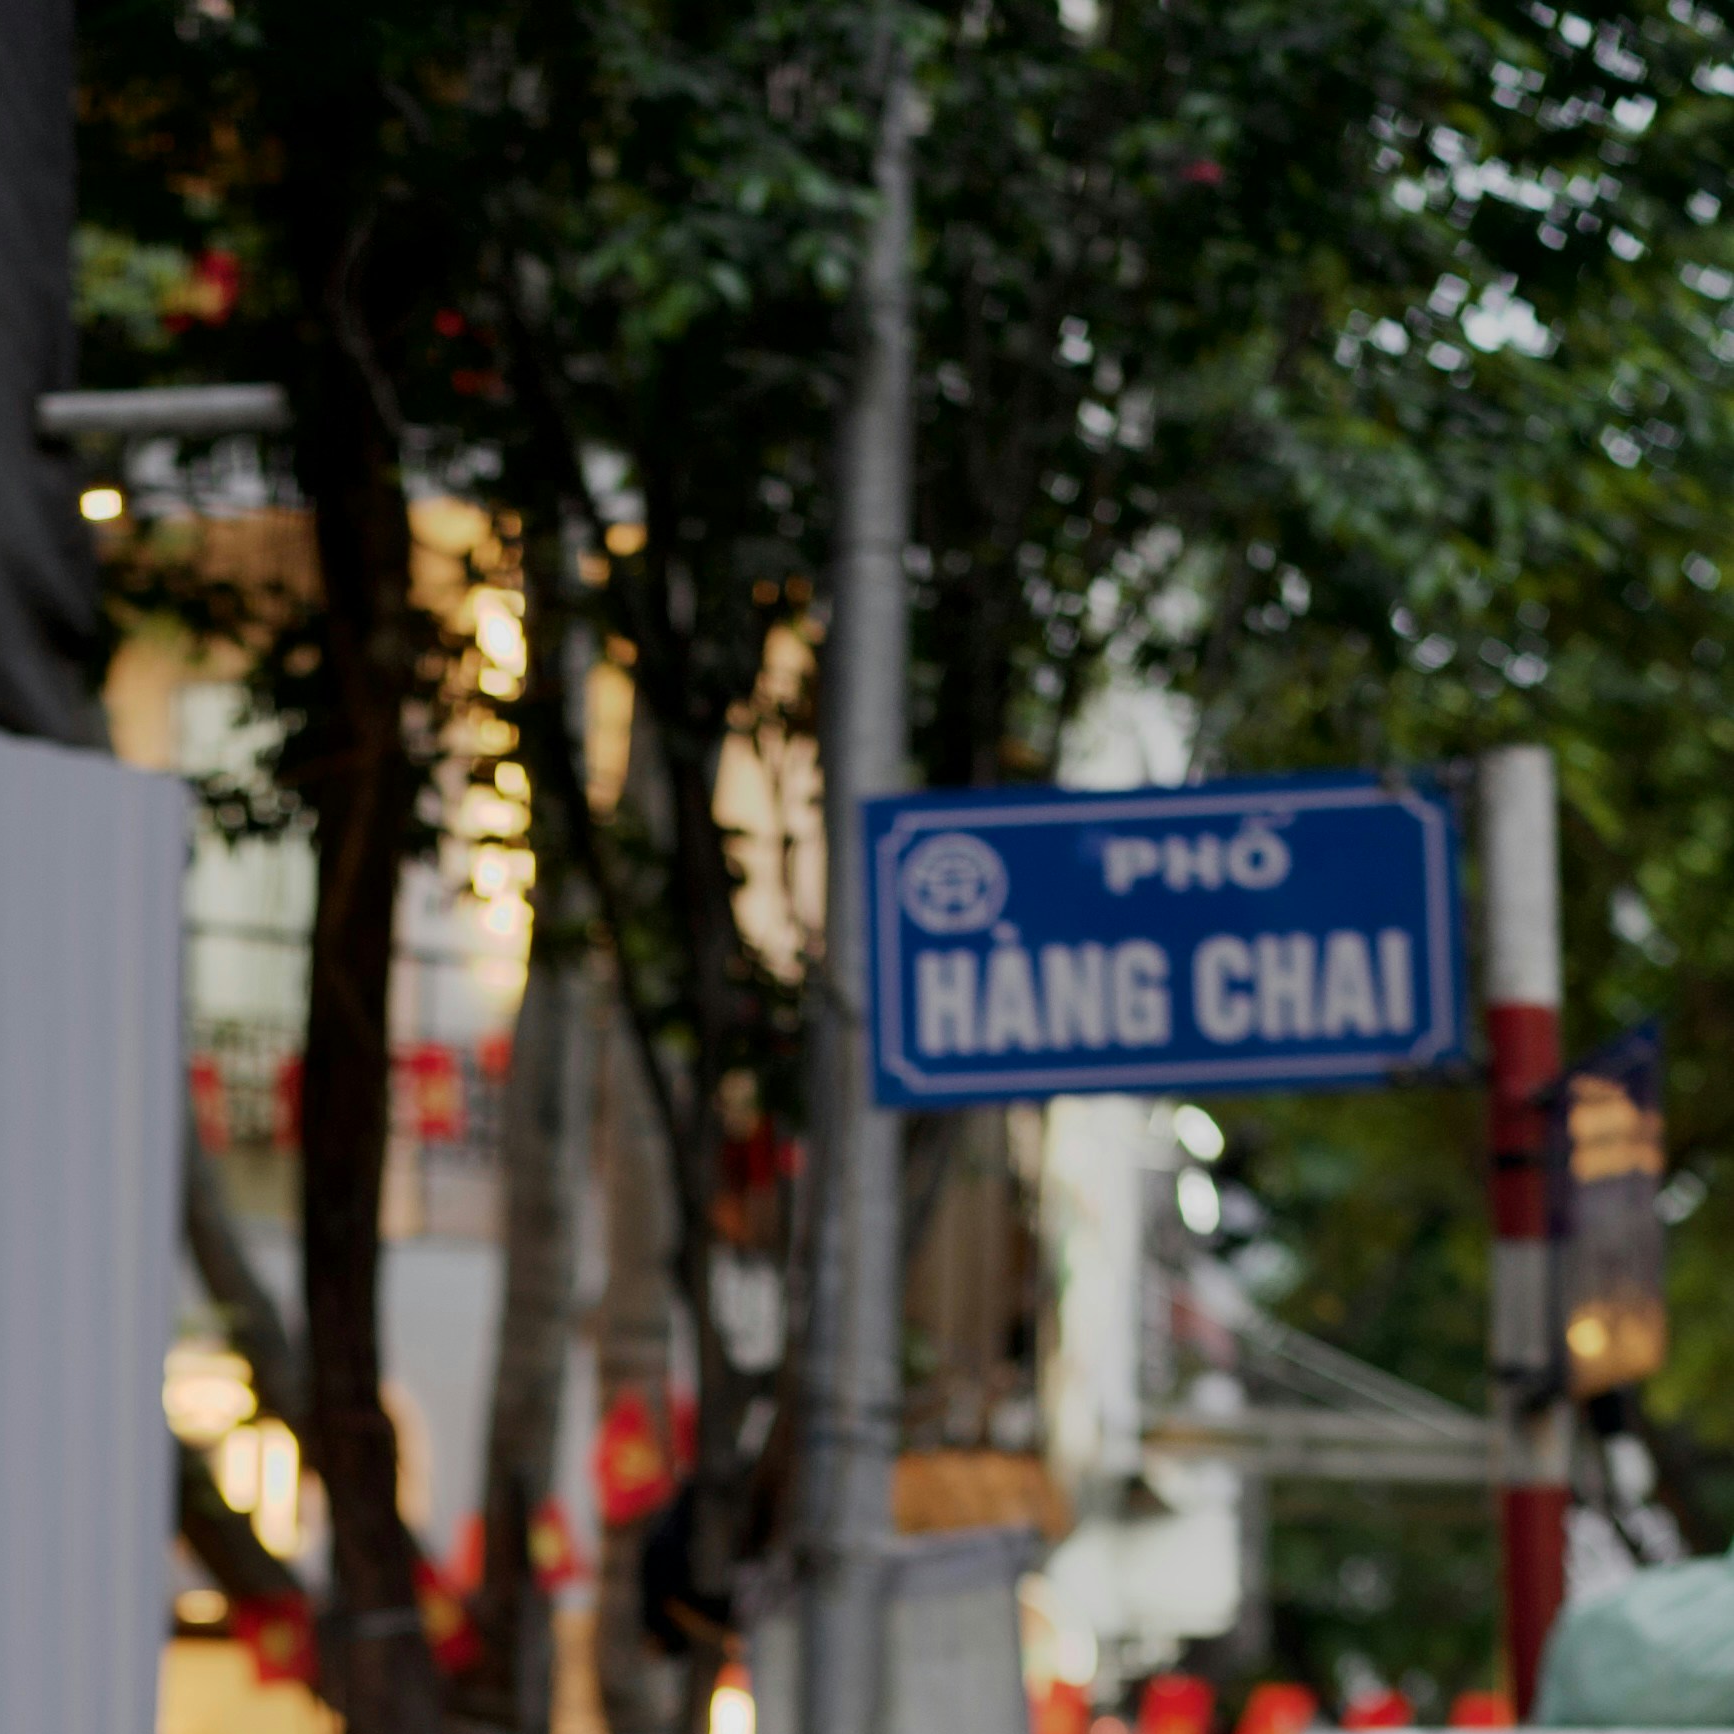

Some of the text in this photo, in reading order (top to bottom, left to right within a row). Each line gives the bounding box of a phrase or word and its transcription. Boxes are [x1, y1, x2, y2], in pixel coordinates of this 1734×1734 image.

[1104, 811, 1294, 894] PHỐ
[916, 920, 1413, 1056] HÀNG CHAI
